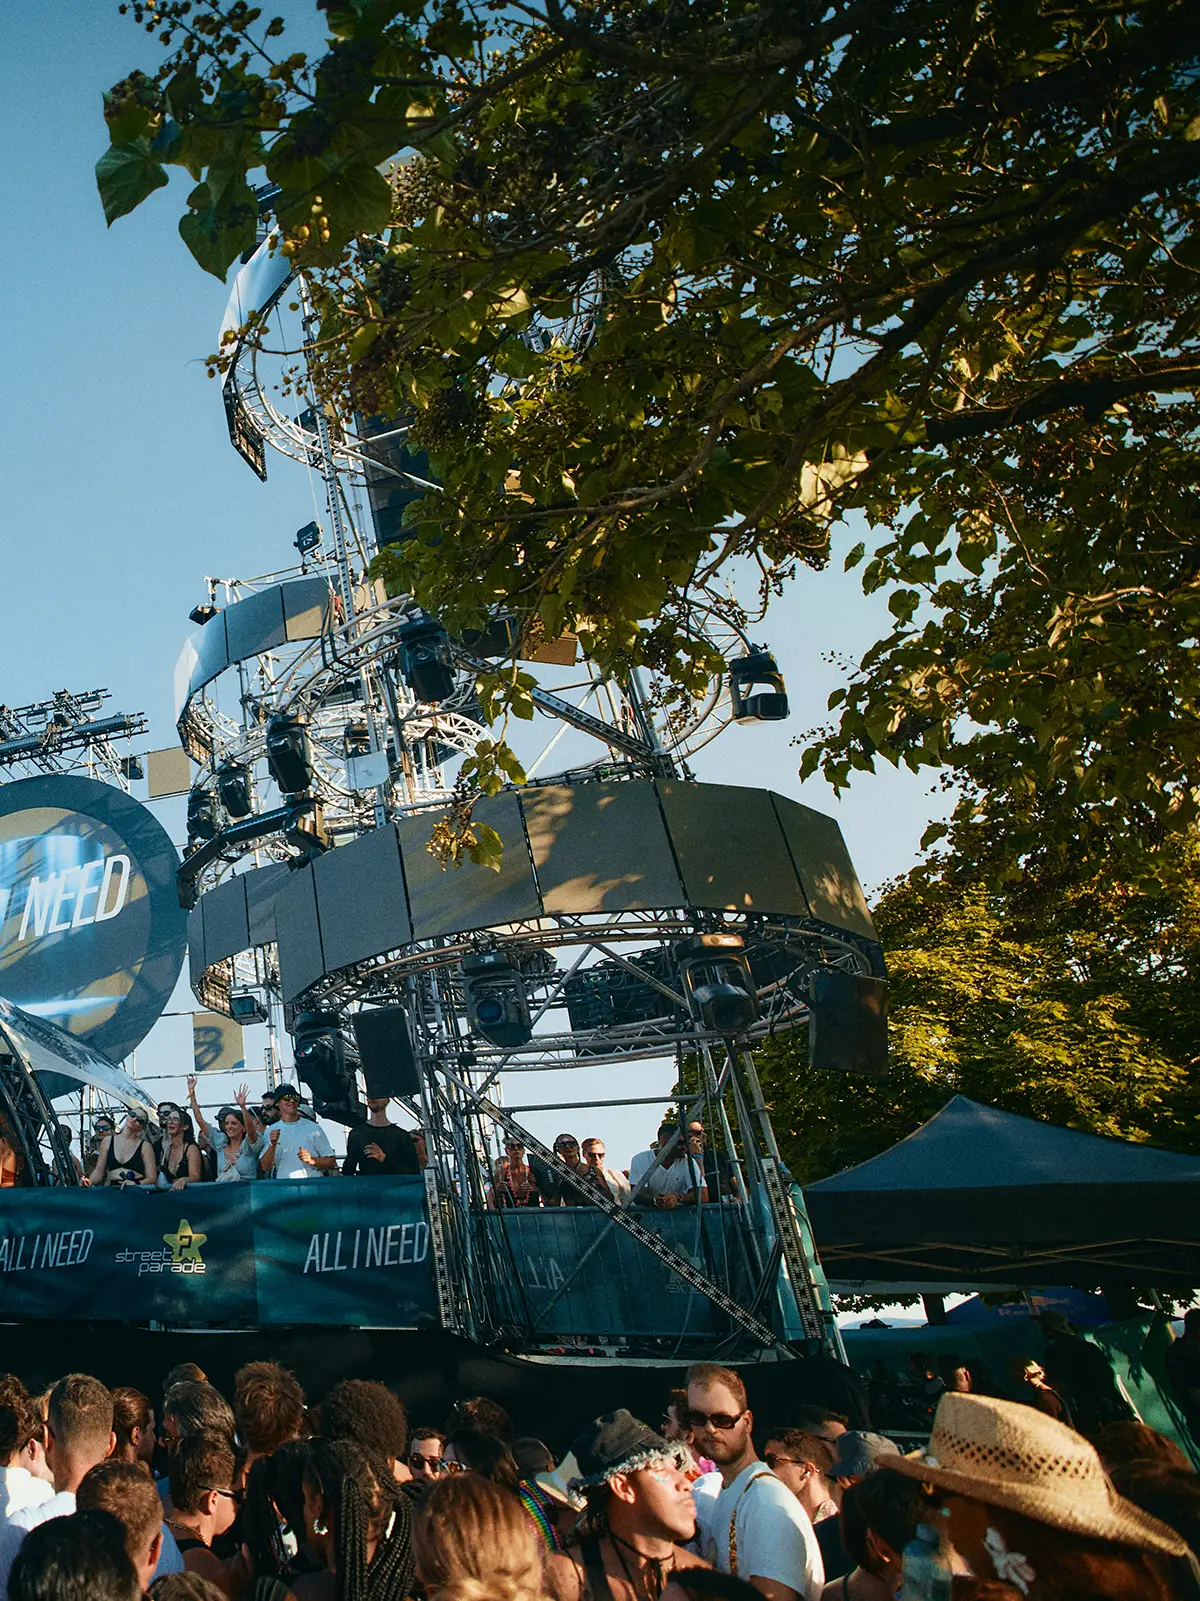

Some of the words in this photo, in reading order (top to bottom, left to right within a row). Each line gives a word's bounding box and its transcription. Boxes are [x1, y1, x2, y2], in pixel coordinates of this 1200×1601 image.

[18, 854, 131, 941] NEED
[30, 1234, 41, 1270] I
[41, 1228, 94, 1269] NEED
[115, 1247, 174, 1263] street
[137, 1259, 207, 1277] parade
[303, 1231, 347, 1274] ALL
[352, 1229, 361, 1269] I
[365, 1221, 430, 1268] NEED
